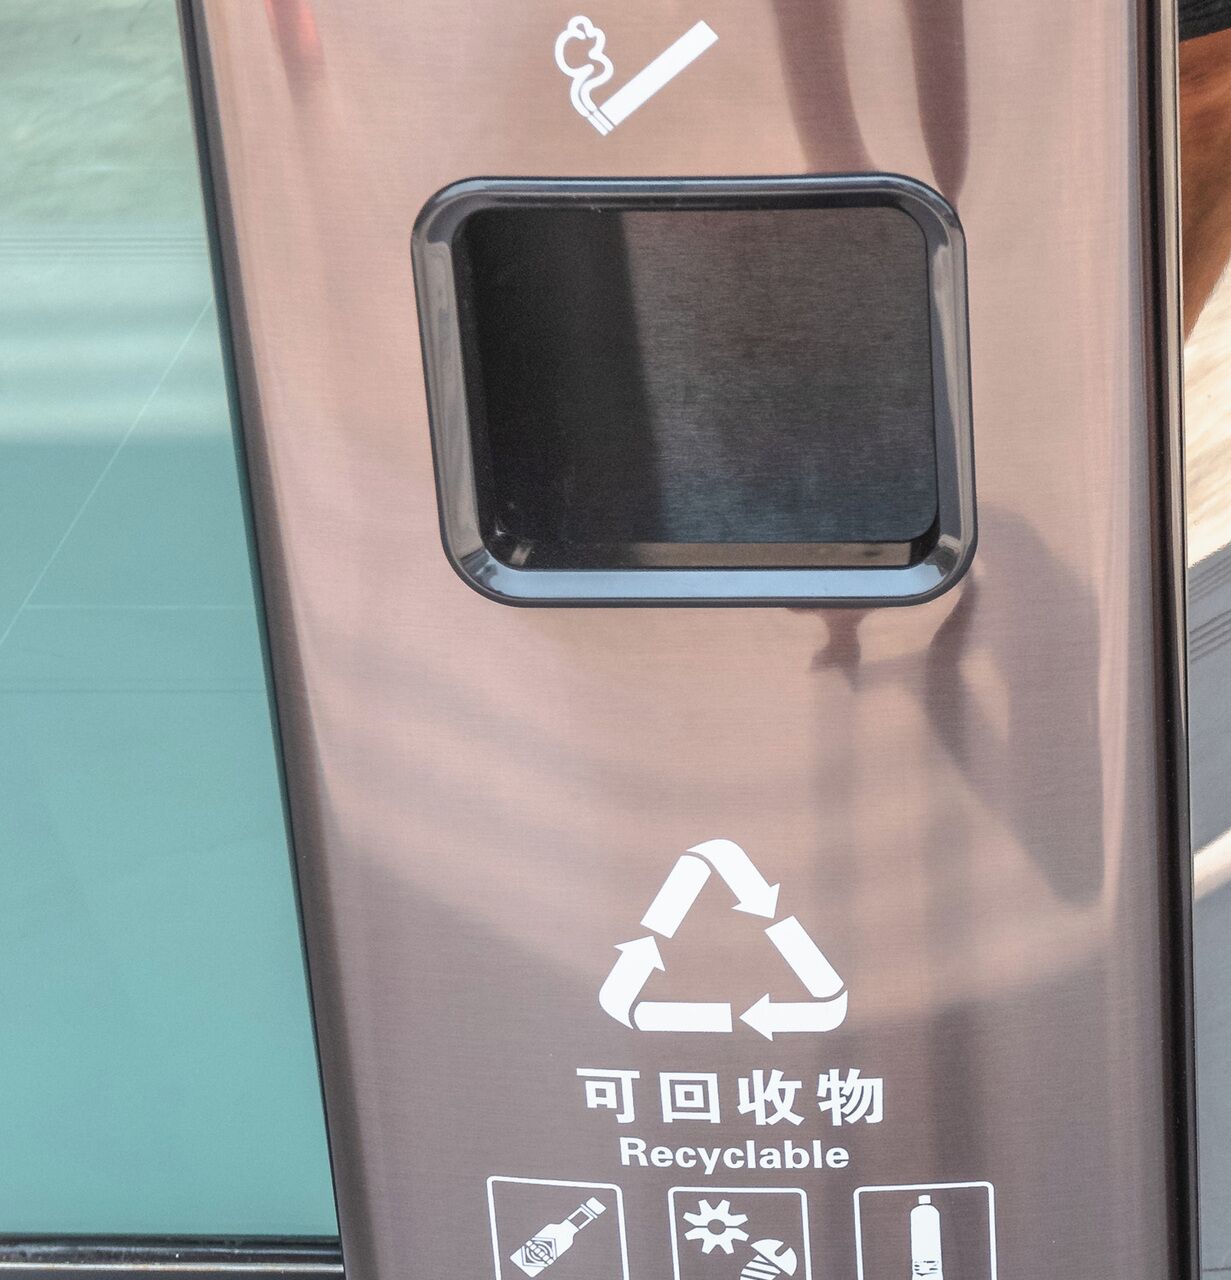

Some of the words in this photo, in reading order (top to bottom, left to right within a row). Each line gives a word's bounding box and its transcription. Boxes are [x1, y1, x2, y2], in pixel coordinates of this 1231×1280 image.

[576, 1067, 884, 1126] 可回收物
[619, 1136, 850, 1175] Recyclable
